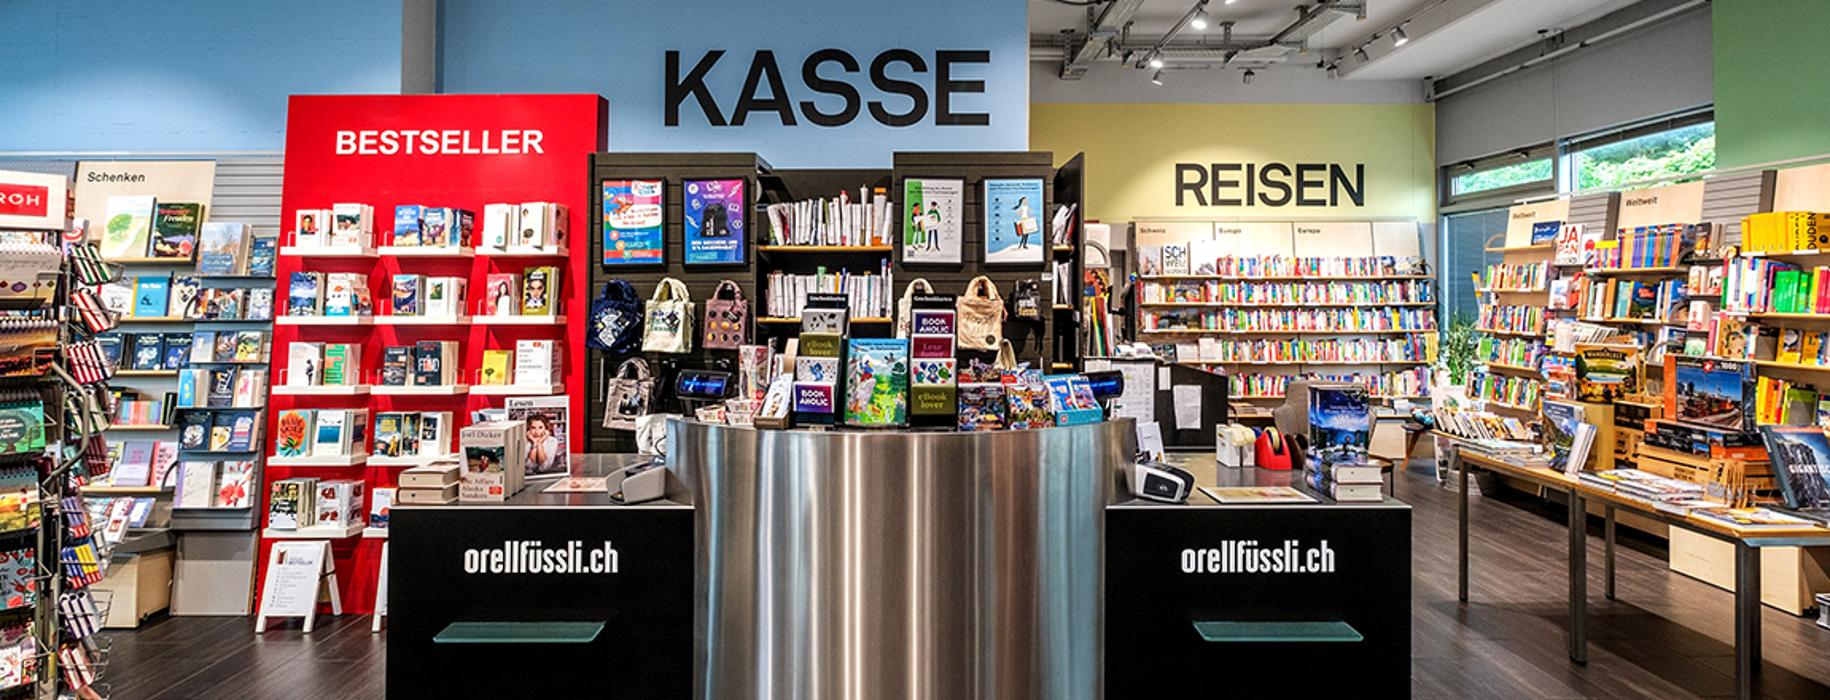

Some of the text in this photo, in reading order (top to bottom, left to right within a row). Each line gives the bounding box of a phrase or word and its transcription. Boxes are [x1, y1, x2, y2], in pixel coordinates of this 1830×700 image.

[664, 48, 990, 127] KASSE
[335, 129, 545, 155] BESTSELLER
[87, 171, 146, 183] Schenken
[1175, 162, 1365, 207] REISEN
[1625, 197, 1658, 207] Weltweit
[1559, 225, 1579, 243] JA
[1806, 212, 1817, 250] DUDEN
[1164, 245, 1186, 258] SCH
[801, 389, 826, 398] BOOK
[509, 399, 534, 407] Lesen
[920, 400, 945, 409] lover
[464, 540, 619, 573] orellfüssli.ch
[1181, 540, 1335, 573] orellfüssli.ch
